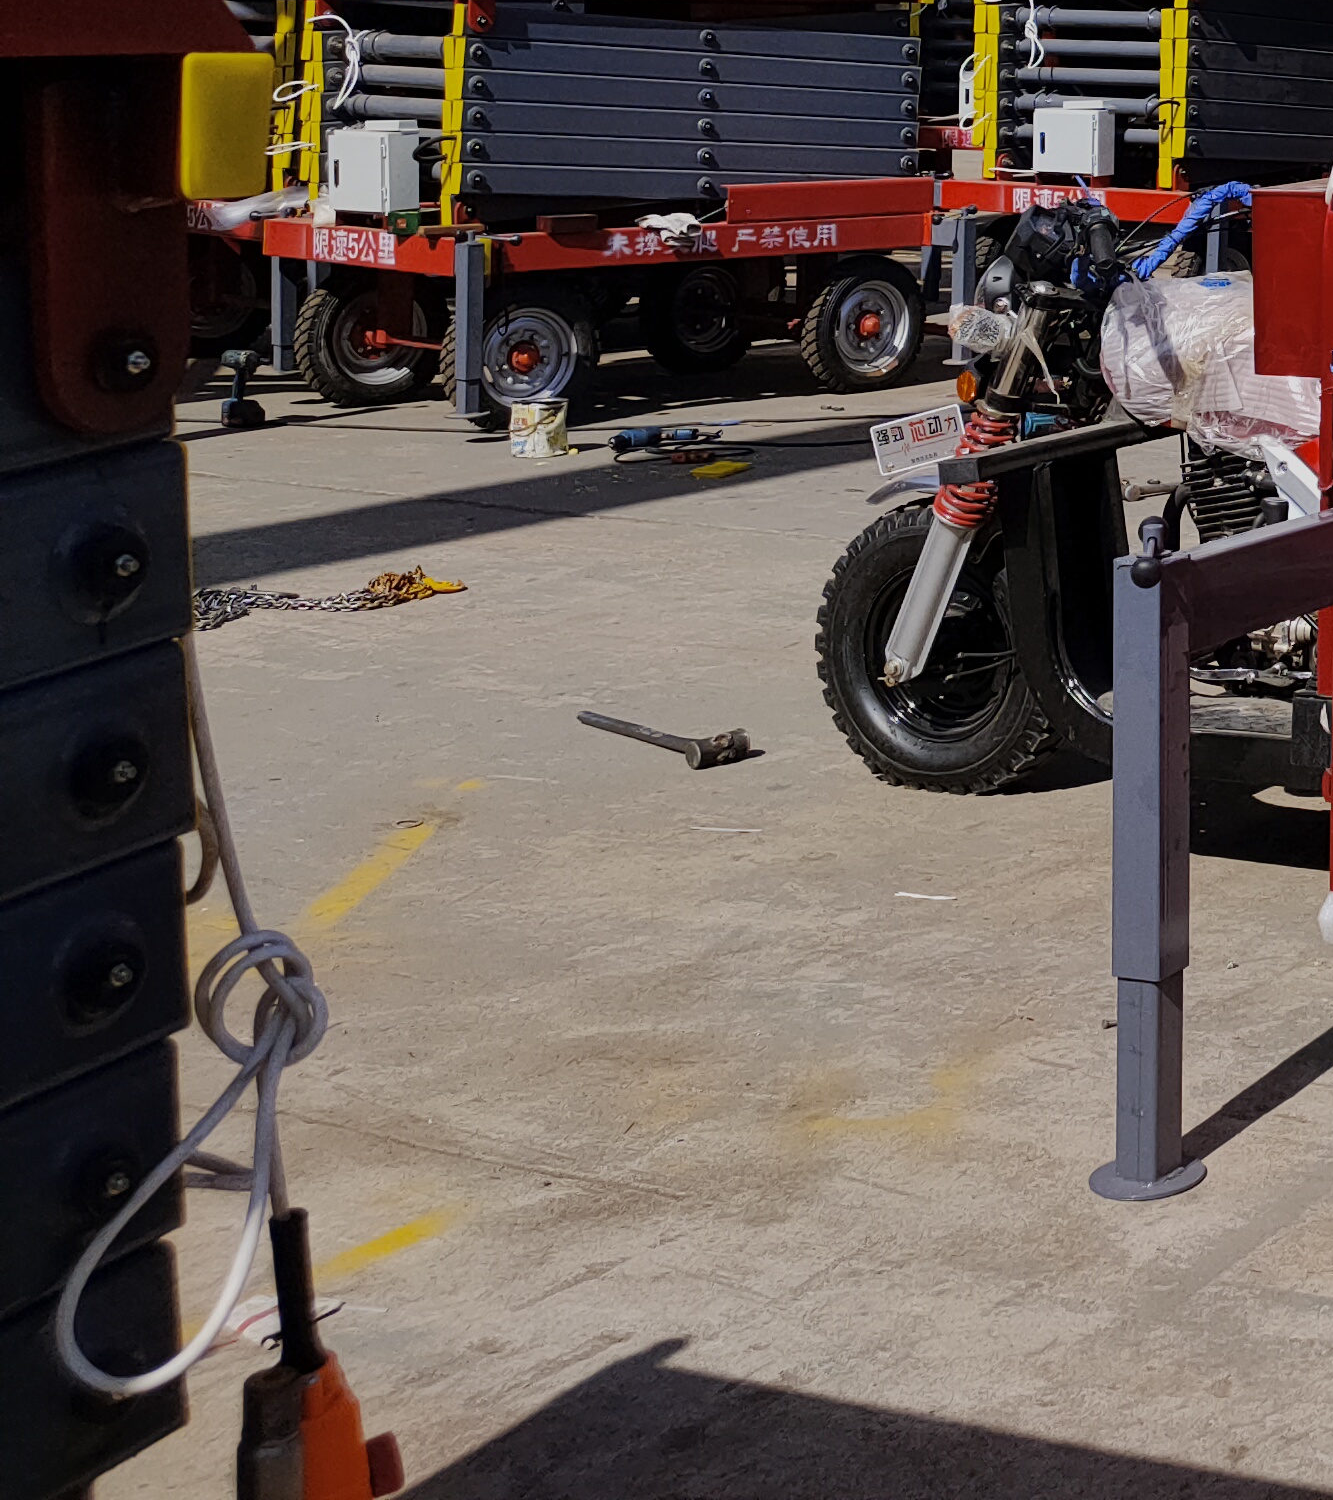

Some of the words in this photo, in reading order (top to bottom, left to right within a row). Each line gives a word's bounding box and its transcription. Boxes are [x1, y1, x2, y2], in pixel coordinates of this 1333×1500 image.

[312, 227, 396, 266] 限速5公里
[731, 223, 838, 252] 严禁使用
